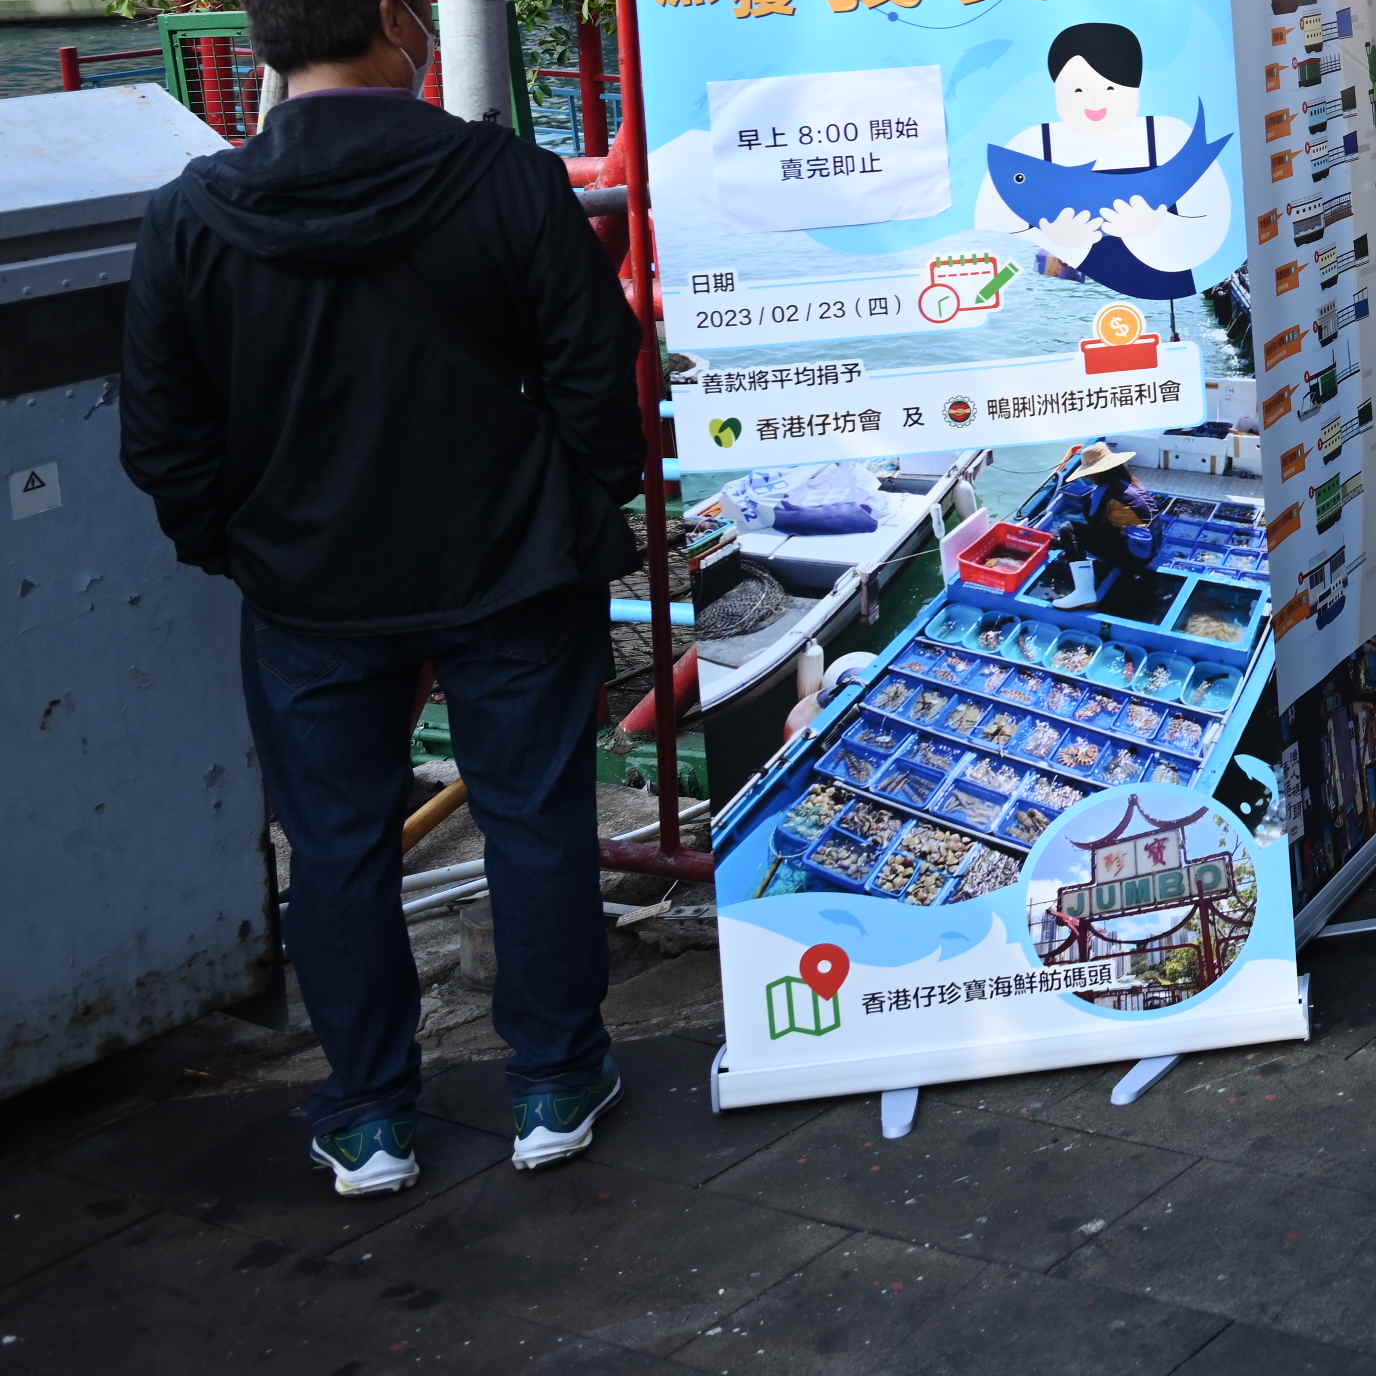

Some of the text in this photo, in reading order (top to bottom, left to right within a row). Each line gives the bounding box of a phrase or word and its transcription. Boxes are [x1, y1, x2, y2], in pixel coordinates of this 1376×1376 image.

[737, 117, 919, 150] 早上 8:00 開始
[780, 152, 883, 182] 賣完即止
[692, 272, 735, 294] 日期
[701, 362, 862, 395] 善款將平均捐予
[756, 379, 1182, 441] 香港仔坊會 及 鴨脷洲街坊福利會
[1066, 864, 1223, 918] JUMBO
[861, 962, 1113, 1015] 香港仔珍寶海鮮舫碼頭
